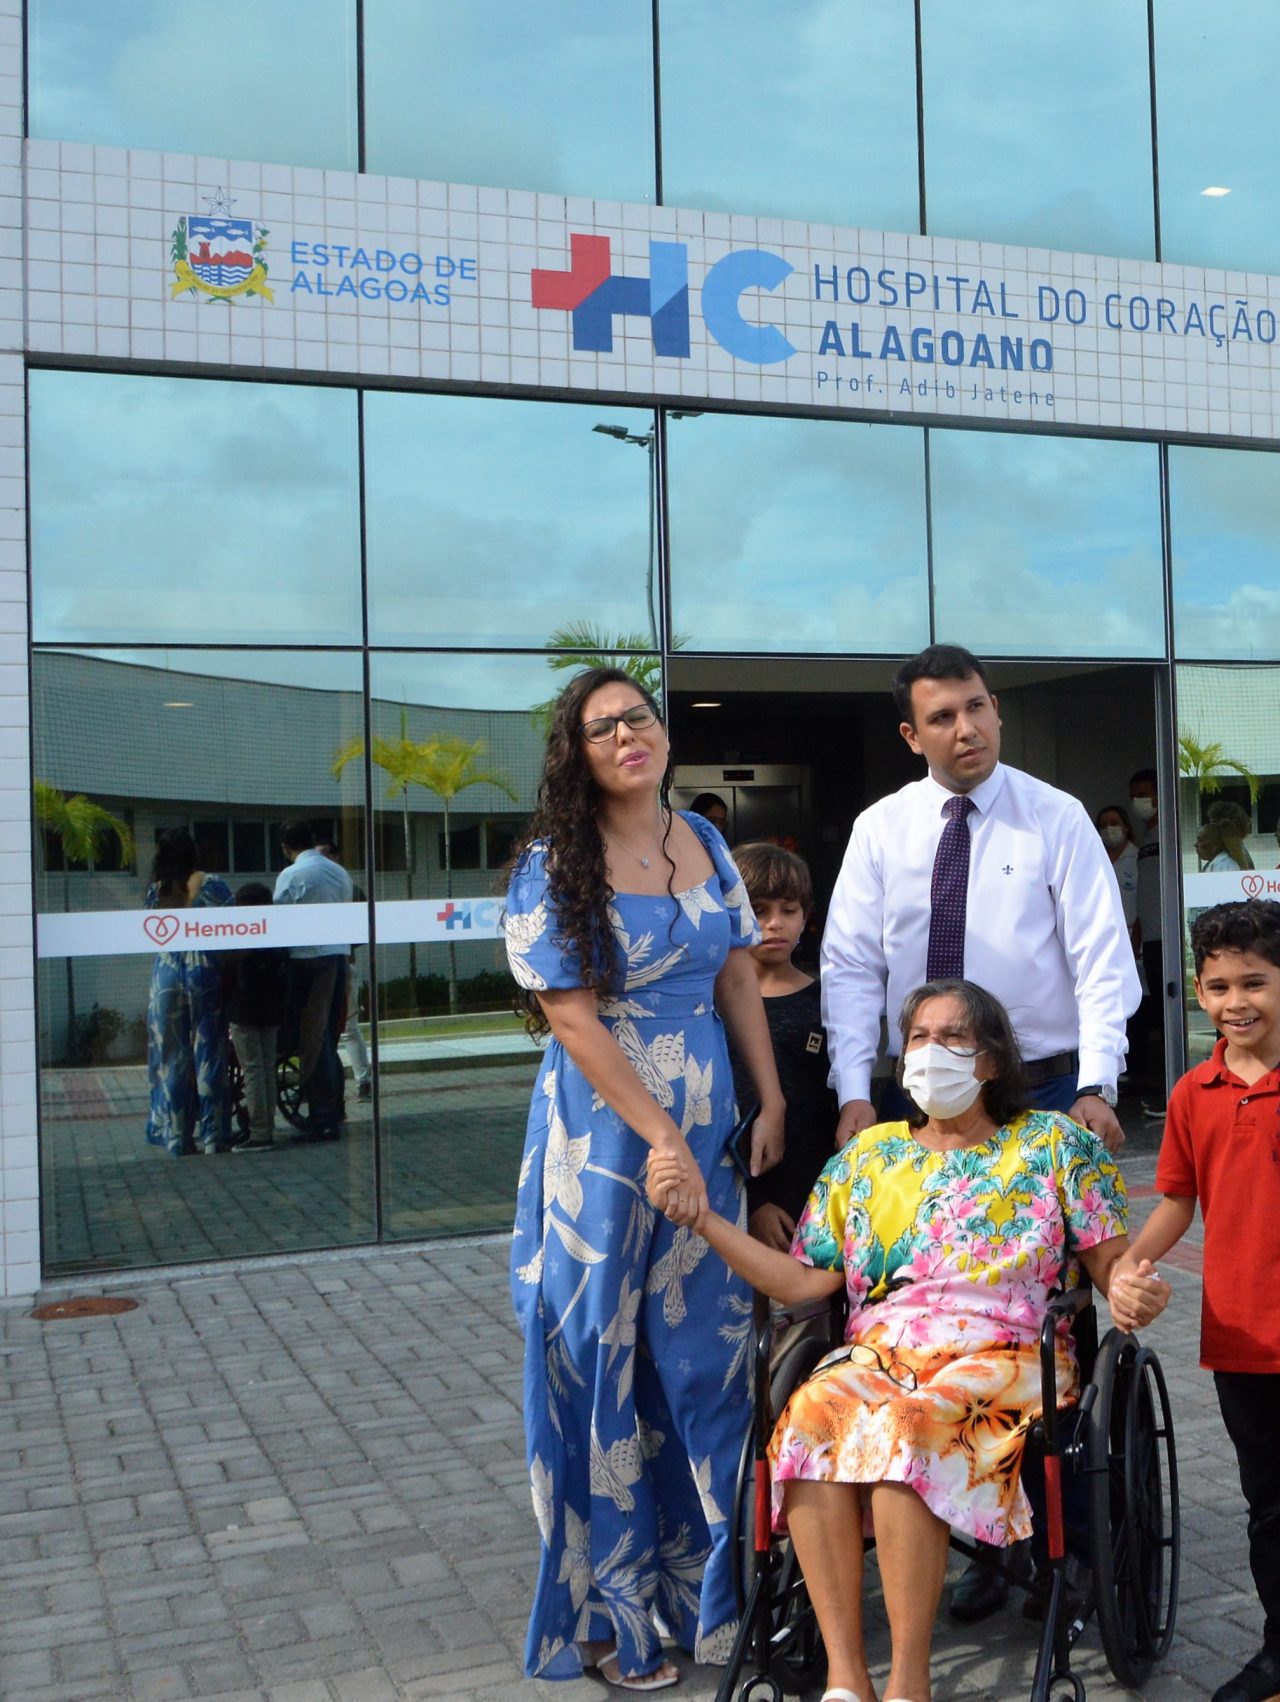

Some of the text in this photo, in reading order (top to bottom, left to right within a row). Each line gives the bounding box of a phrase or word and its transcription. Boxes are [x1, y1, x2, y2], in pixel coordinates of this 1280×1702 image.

[290, 240, 477, 281] ESTADO DE
[290, 270, 451, 306] ALAGOAS
[531, 233, 797, 364] HC
[814, 263, 1276, 348] HOSPITAL DO CORAÇÃO
[818, 320, 1054, 373] ALAGOANO
[817, 371, 1055, 407] Prof. Adib Jatene
[184, 918, 267, 938] Hemoal
[437, 901, 496, 930] HC
